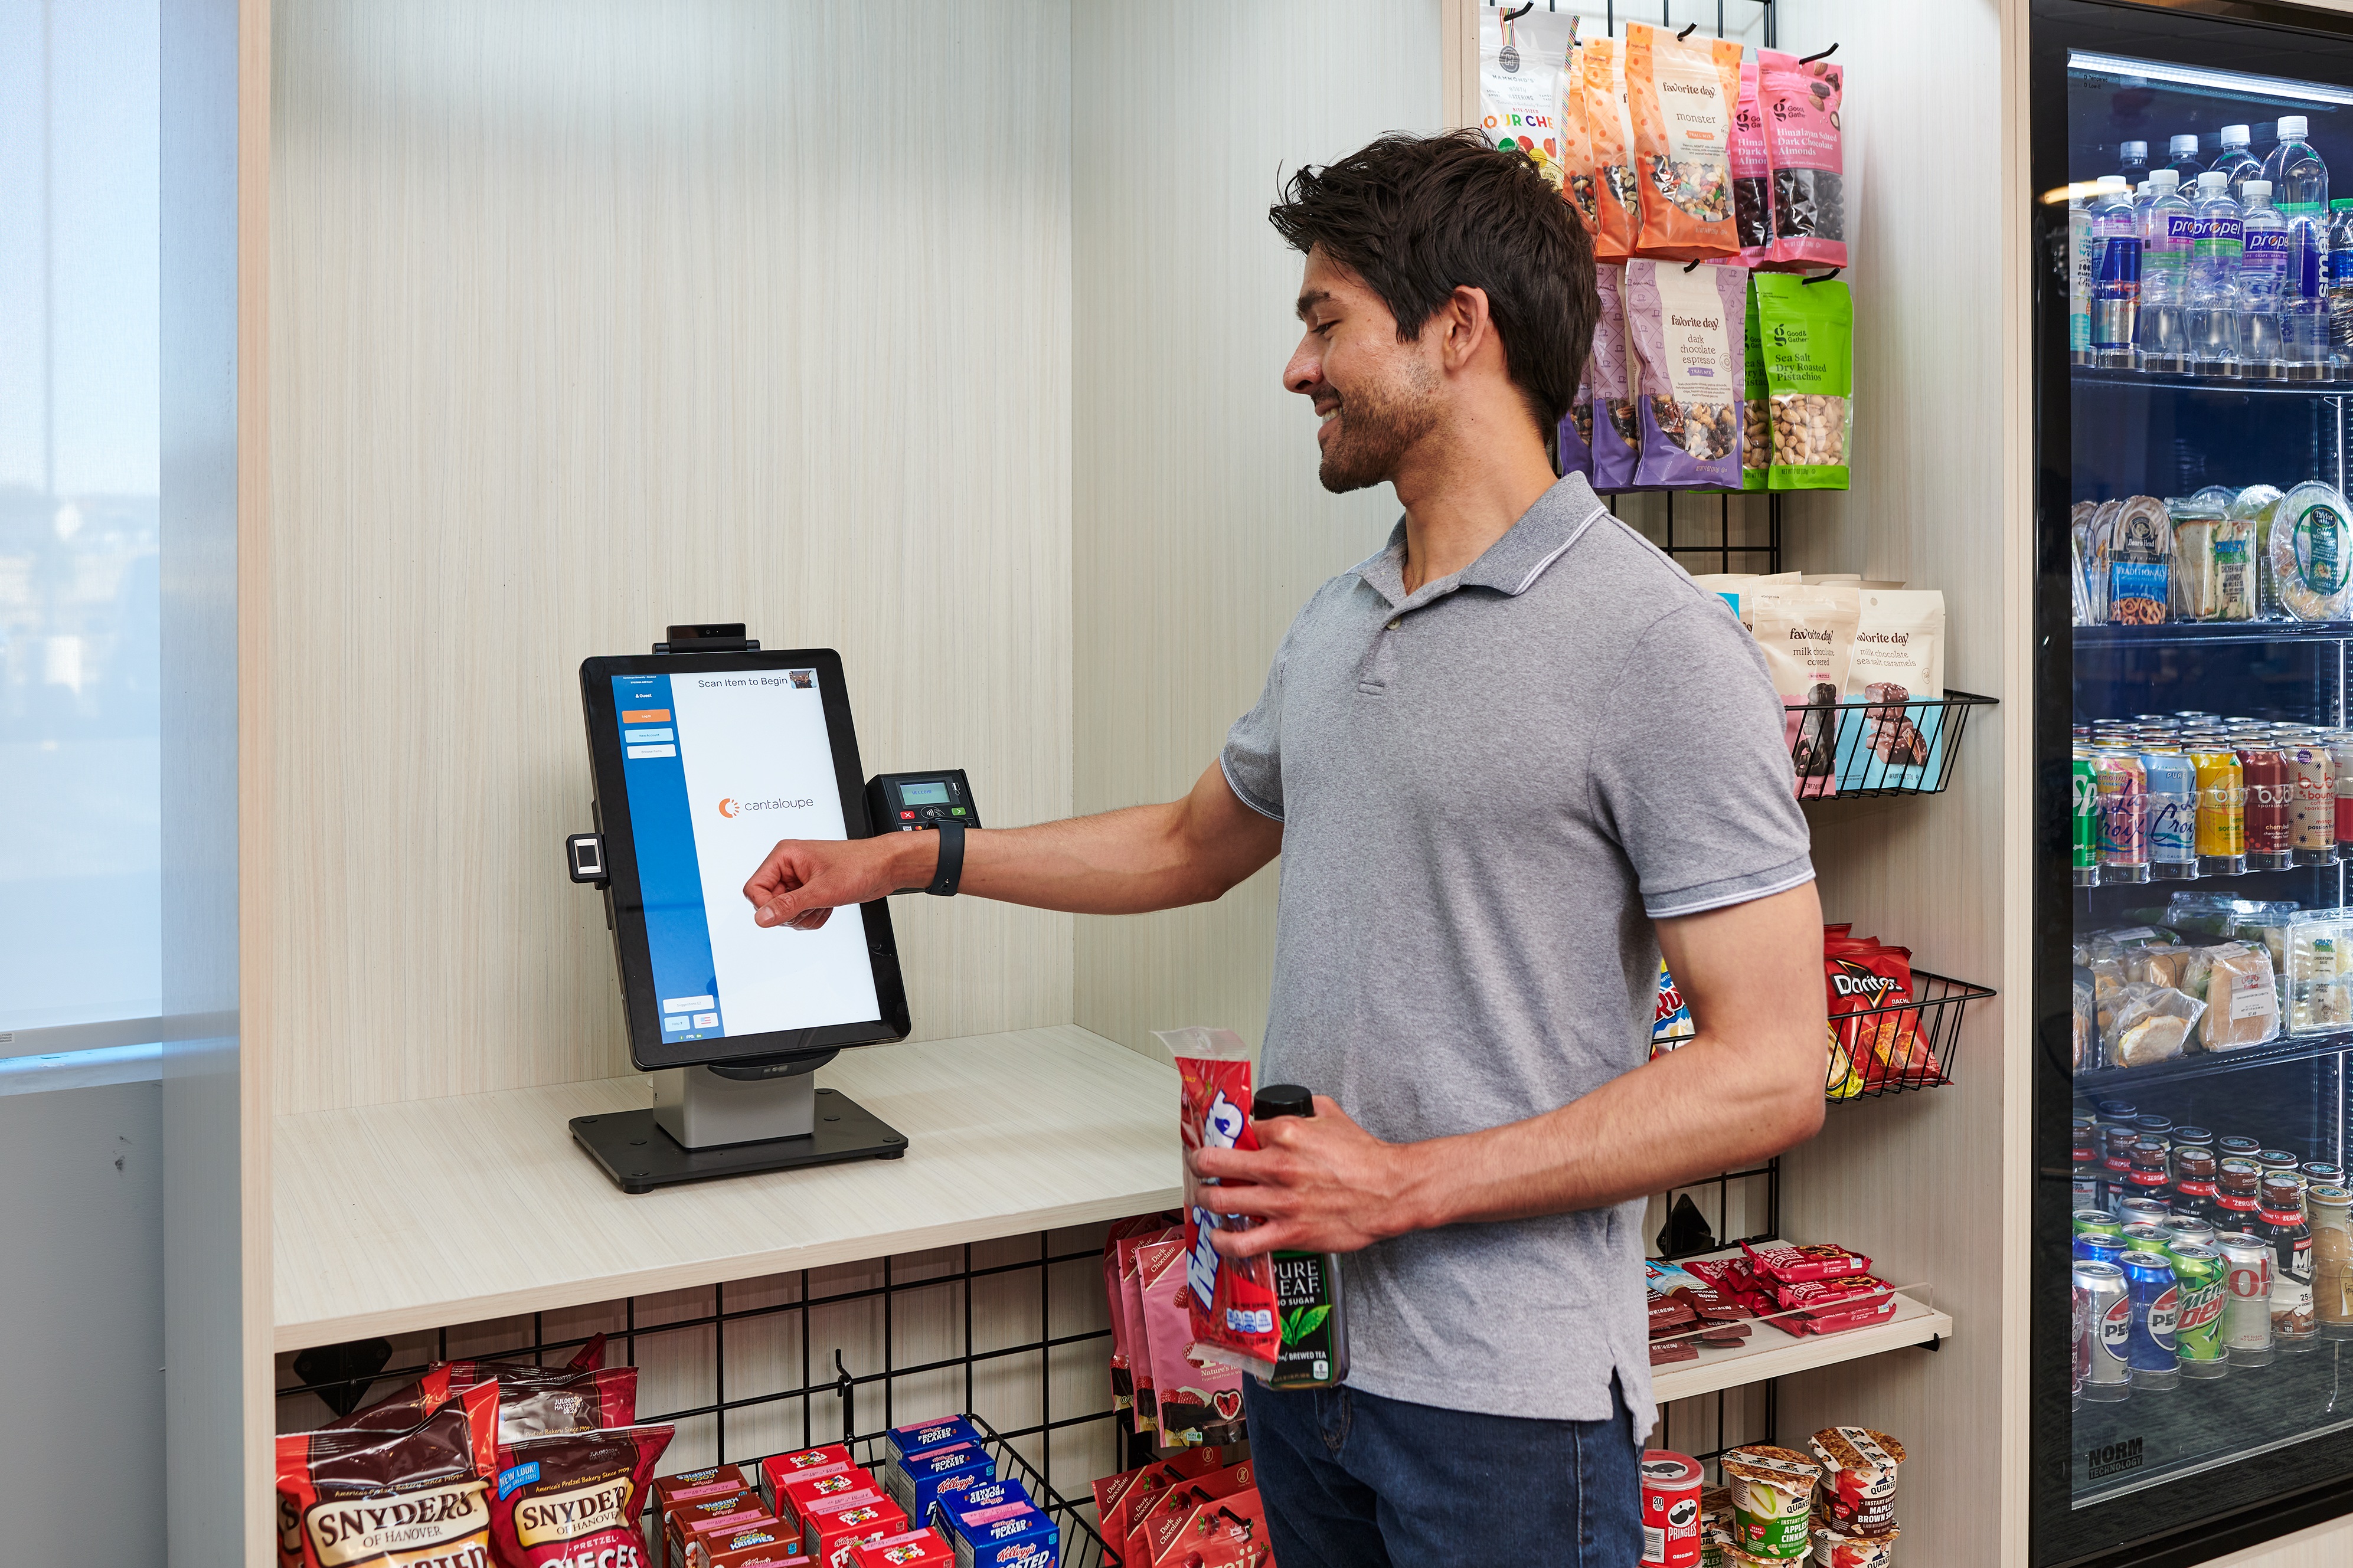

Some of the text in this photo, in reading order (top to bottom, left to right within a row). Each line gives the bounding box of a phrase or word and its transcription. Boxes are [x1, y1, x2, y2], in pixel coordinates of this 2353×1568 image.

[1664, 82, 1715, 99] favorite day
[1676, 113, 1715, 124] monster
[1777, 128, 1837, 142] Himalayan Salted
[1802, 138, 1833, 150] Chocolate
[1779, 147, 1816, 156] Almonds
[2194, 222, 2241, 235] propel
[2318, 216, 2328, 299] smart
[1671, 315, 1719, 330] favorite day
[1688, 334, 1705, 344] dark
[1680, 345, 1715, 354] chocolate
[1682, 356, 1715, 365] espresso
[1776, 353, 1811, 362] Sea Salt
[1776, 363, 1826, 373] Dry Roasted
[1777, 372, 1822, 381] Pistachios
[2315, 510, 2334, 521] Taylor
[2143, 539, 2155, 548] Head
[2215, 540, 2246, 553] CRAZY
[2215, 551, 2246, 565] FRESH
[1789, 628, 1834, 644] favorite day
[1891, 633, 1909, 647] day
[1793, 647, 1812, 656] milk
[1860, 648, 1909, 659] milk chocolate
[1808, 658, 1830, 666] covered
[1871, 657, 1883, 666] salt
[761, 676, 787, 687] Begin
[744, 798, 813, 811] cantaloupe
[2112, 779, 2141, 817] La
[1834, 975, 1903, 995] Doritos
[1151, 1246, 1166, 1263] Dark
[1151, 1246, 1176, 1273] Chocolate
[1289, 1296, 1315, 1305] SUGAR
[1289, 1350, 1326, 1361] BREWED TEA
[1201, 1365, 1229, 1377] Nature's
[525, 1429, 544, 1439] Pretzel
[918, 1428, 952, 1441] FROSTED
[1842, 1428, 1854, 1440] QUAKER
[2090, 1436, 2143, 1468] NORM
[931, 1454, 965, 1469] FROSTED
[936, 1458, 965, 1472] FLAKES
[2090, 1455, 2142, 1478] TECHNOLOGY
[499, 1464, 537, 1488] NEW LOOK!
[677, 1468, 719, 1481] KRISPIES
[684, 1473, 715, 1482] COCOA
[423, 1477, 444, 1486] Since
[502, 1473, 537, 1494] SAME GREAT TASTE
[535, 1482, 561, 1492] America's
[561, 1477, 581, 1488] Pretzel
[581, 1475, 601, 1484] Bakery
[937, 1475, 975, 1494] Kellogg's
[1107, 1478, 1120, 1494] Dark
[1871, 1481, 1896, 1495] QUAKER
[1106, 1476, 1129, 1504] Chocolate
[1133, 1494, 1157, 1521] Chocolate
[1135, 1495, 1149, 1513] Dark
[1653, 1497, 1664, 1506] 200
[1870, 1505, 1890, 1515] MAPLE
[1858, 1514, 1885, 1523] BROWN
[556, 1524, 569, 1536] OF
[991, 1519, 1026, 1537] FROSTED
[996, 1525, 1026, 1539] FLAKES
[1159, 1517, 1175, 1534] Dark
[1159, 1515, 1183, 1545] Chocolate
[1668, 1521, 1697, 1541] PRINGLES
[1784, 1523, 1806, 1534] APPLES
[362, 1526, 443, 1548] OF HANOVER
[730, 1534, 775, 1551] KRISPIES
[733, 1532, 767, 1543] COCOA
[573, 1537, 616, 1551] PRETZEL
[997, 1543, 1037, 1563] Kellogg's
[1673, 1551, 1694, 1559] ORIGINAL
